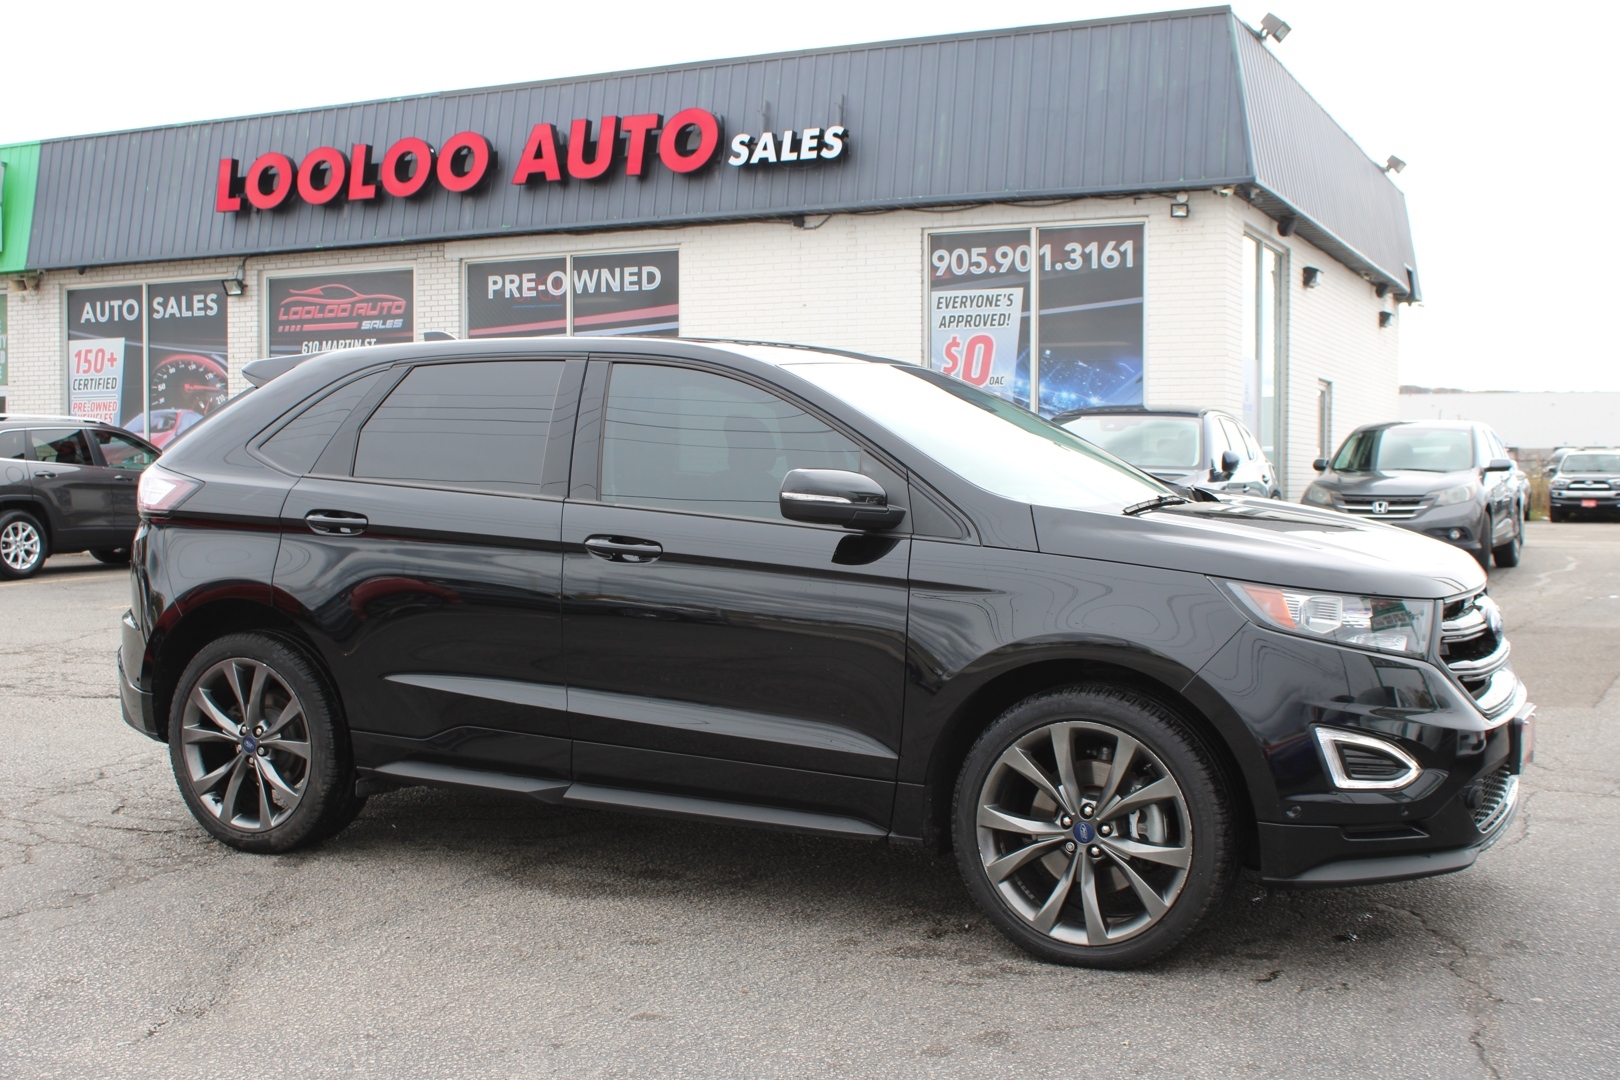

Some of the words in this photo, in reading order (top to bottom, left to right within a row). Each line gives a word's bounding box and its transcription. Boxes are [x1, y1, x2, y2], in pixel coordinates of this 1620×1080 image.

[216, 131, 492, 212] LOOLOO
[511, 107, 720, 185] AUTO
[728, 125, 847, 167] SALES
[931, 240, 1134, 277] 905.901.3161
[487, 265, 662, 299] PRE-OWNED
[80, 298, 140, 324] AUTO
[152, 293, 218, 320] SALES
[936, 293, 1014, 310] EVERYONE'S
[278, 304, 352, 321] LOOLOO
[352, 301, 407, 317] AUTO
[361, 318, 404, 330] SALES
[938, 312, 1011, 329] APPROVED!
[301, 341, 320, 354] 610
[322, 339, 362, 352] MARTIN
[74, 347, 118, 375] 150+
[942, 334, 995, 386] $0
[72, 377, 118, 391] CERTIFIED
[988, 376, 1005, 385] OAC
[72, 401, 118, 413] PRE-OWNED
